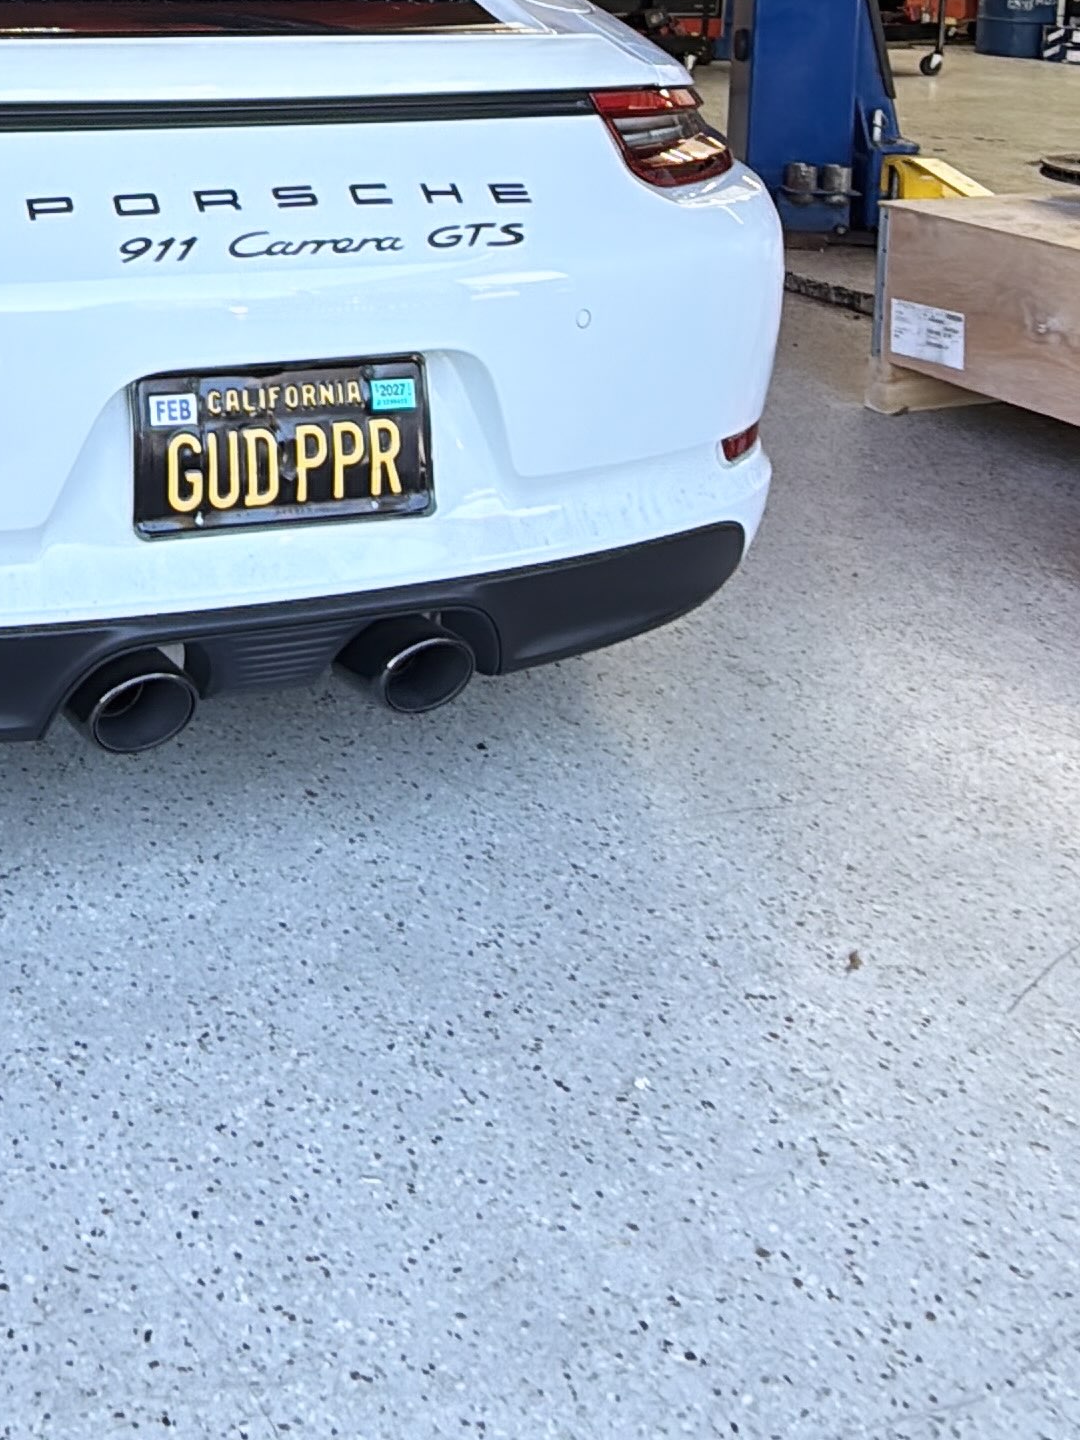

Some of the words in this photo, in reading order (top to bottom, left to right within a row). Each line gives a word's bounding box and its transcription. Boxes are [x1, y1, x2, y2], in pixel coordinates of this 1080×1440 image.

[25, 182, 533, 222] PORSCHE
[119, 235, 200, 264] 911
[228, 230, 405, 260] Carrera
[426, 222, 527, 250] GTS
[206, 380, 363, 416] CALIFORNIA
[379, 383, 406, 397] 2027
[156, 398, 192, 422] FEB
[167, 432, 280, 513] GUD
[295, 417, 403, 503] PPR
